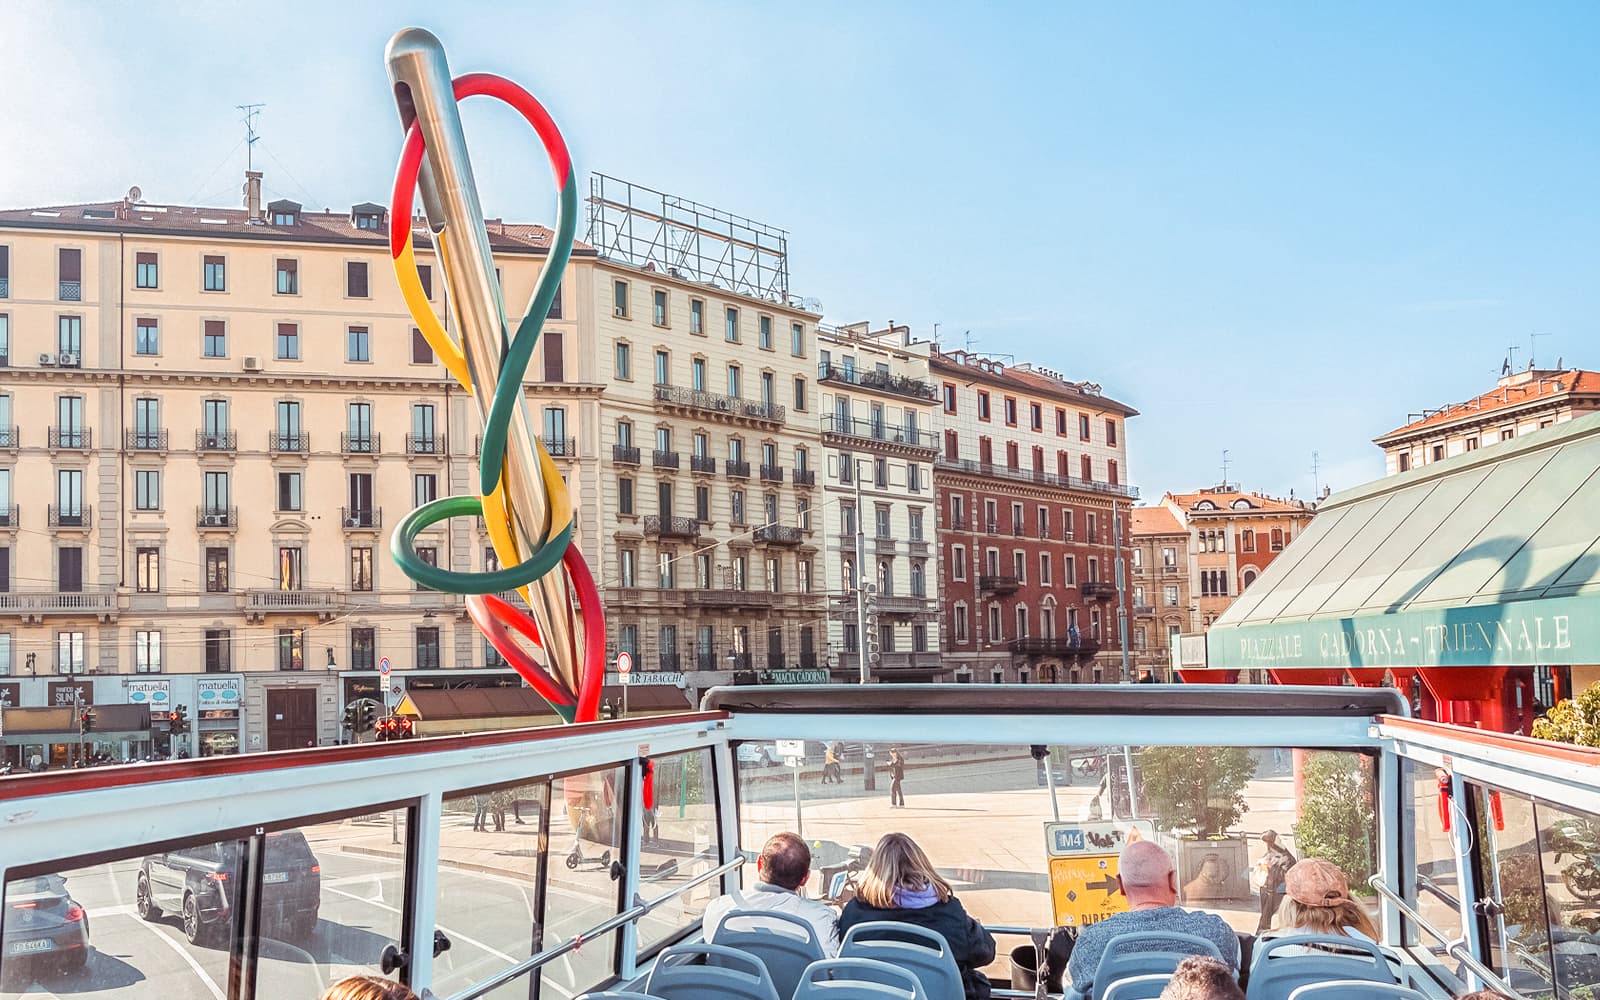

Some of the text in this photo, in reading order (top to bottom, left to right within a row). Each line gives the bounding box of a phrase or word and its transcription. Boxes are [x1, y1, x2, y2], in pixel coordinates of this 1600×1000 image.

[1240, 635, 1303, 660] PIAZZALE
[1320, 628, 1406, 658] CADORNA
[1425, 615, 1571, 651] TRIENNALE
[644, 672, 682, 683] TABACCHI
[797, 671, 826, 682] CADORNA
[129, 681, 168, 692] matuella
[199, 680, 237, 690] matuella
[1060, 833, 1082, 847] M4
[1081, 912, 1115, 926] DIREZ
